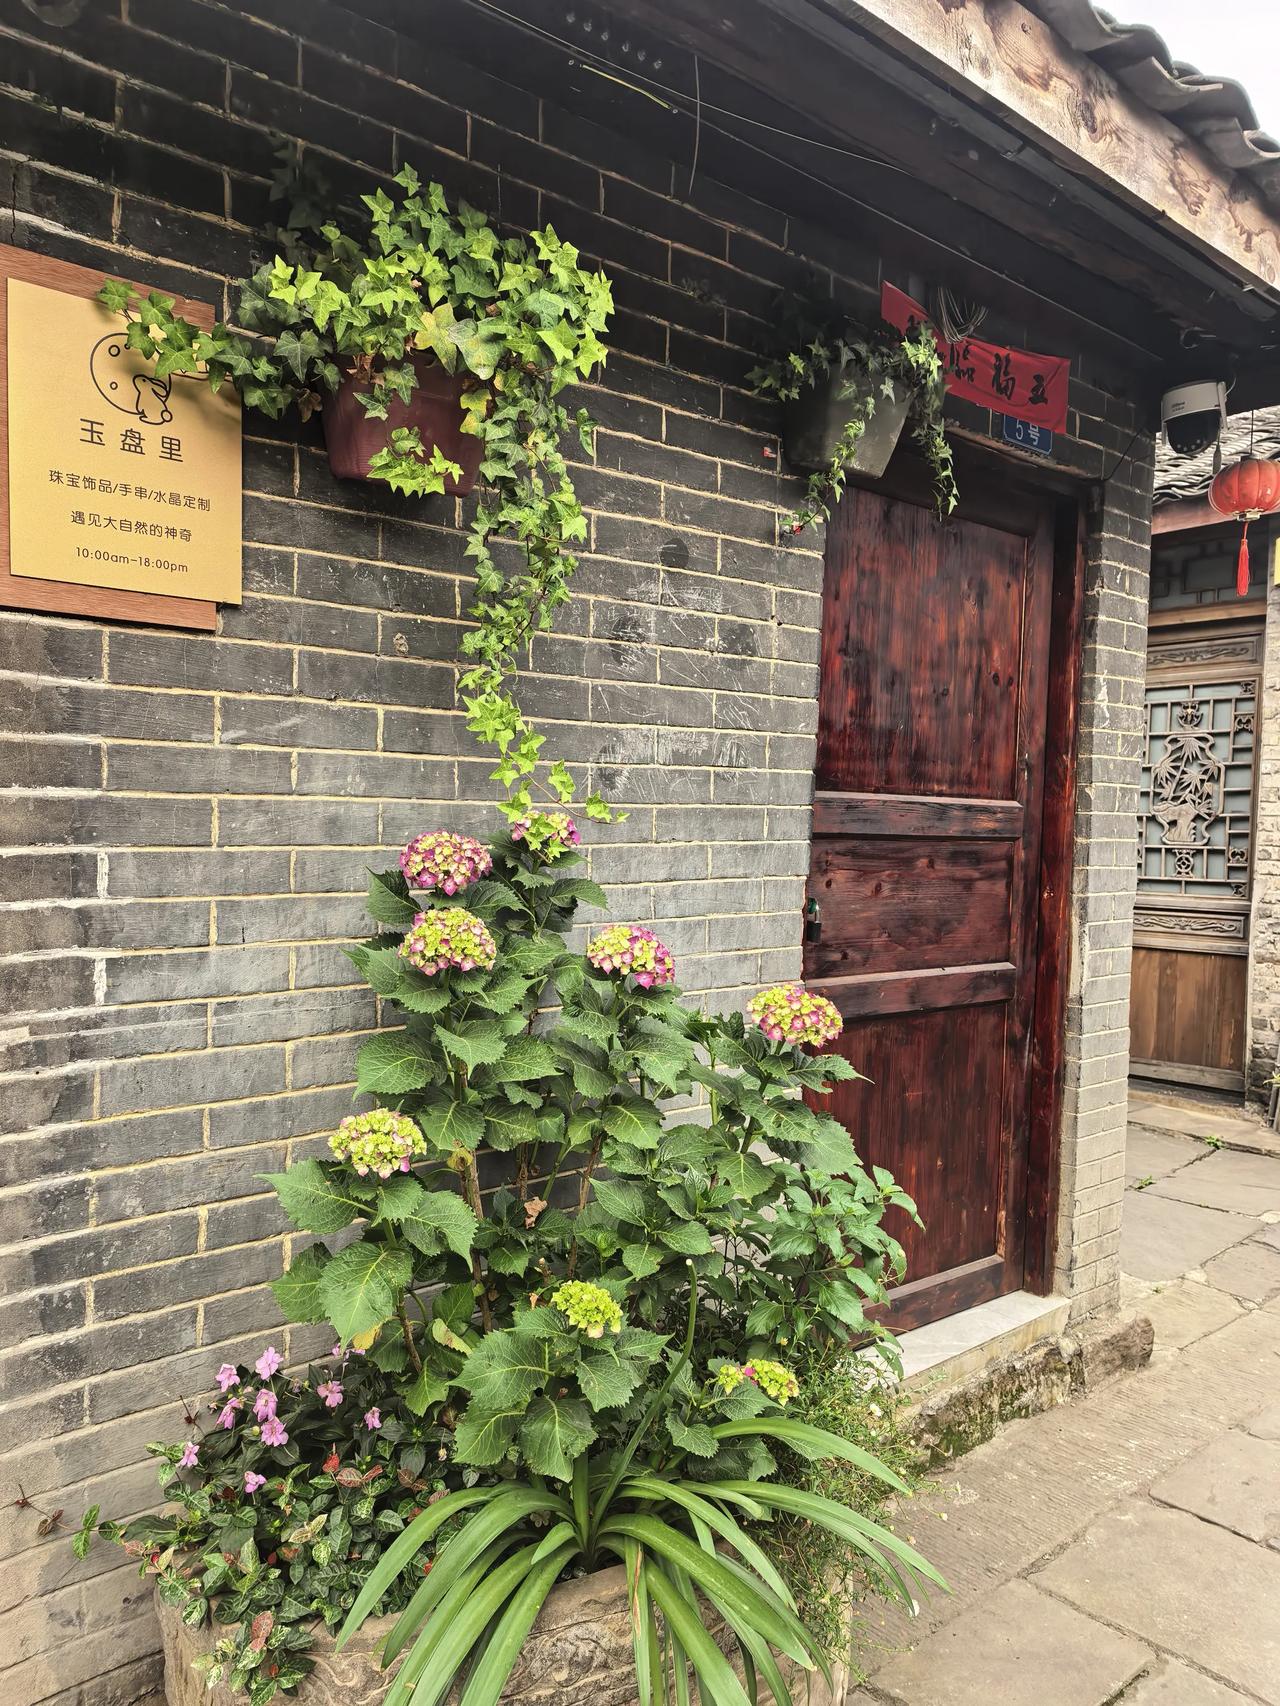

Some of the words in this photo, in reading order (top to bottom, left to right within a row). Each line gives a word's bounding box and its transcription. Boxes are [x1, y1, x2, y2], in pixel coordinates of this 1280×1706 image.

[79, 418, 184, 462] 玉盘里
[1015, 418, 1041, 446] 5号
[49, 469, 211, 512] 珠宝饰品/手串/水晶定制
[70, 510, 193, 543] 遇见大自然的神奇
[75, 546, 189, 573] 10:00am-18:00pm
